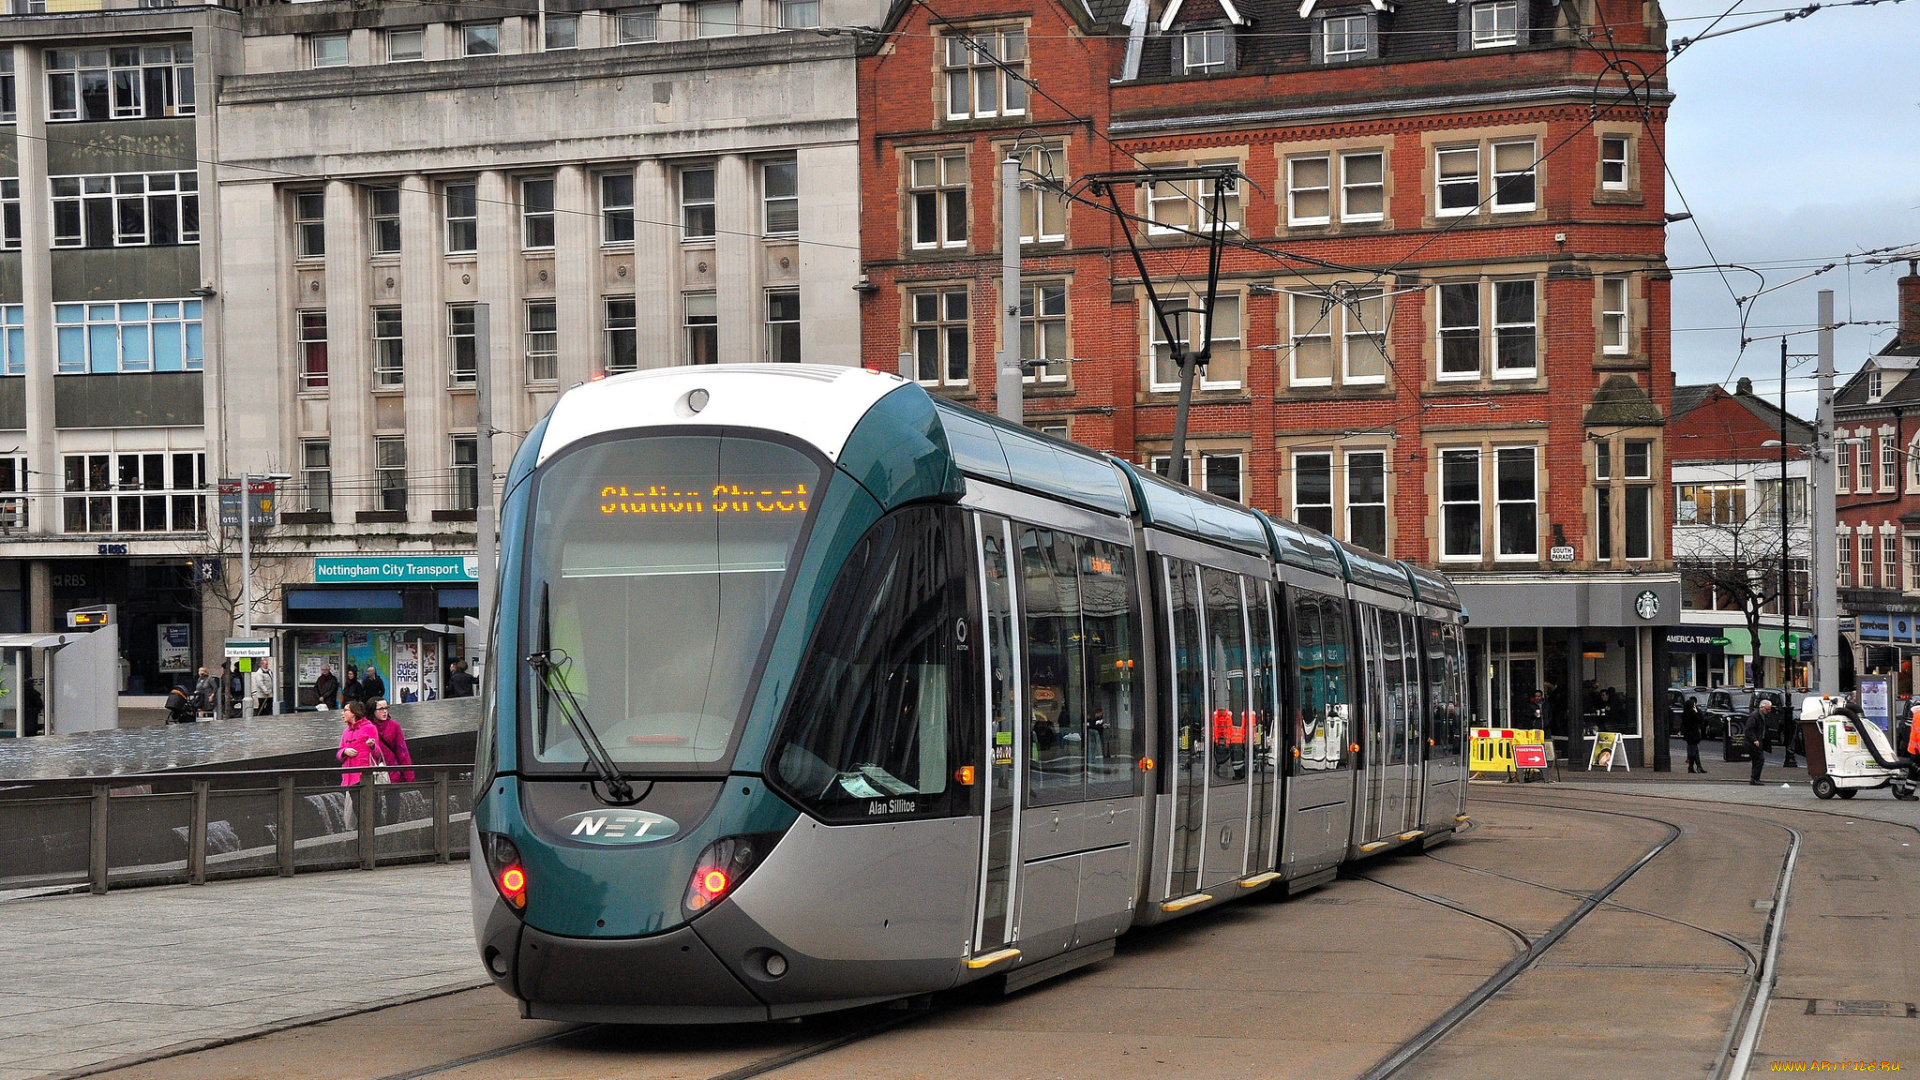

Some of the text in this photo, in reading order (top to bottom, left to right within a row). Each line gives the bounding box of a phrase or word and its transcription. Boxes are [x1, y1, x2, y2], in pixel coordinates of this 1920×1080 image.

[601, 484, 807, 513] Station Street
[108, 544, 127, 554] RBS
[1551, 553, 1573, 561] PARADE
[318, 563, 459, 578] Nottingham City Transport
[64, 574, 87, 587] RBS
[1666, 635, 1695, 644] AMERICA
[397, 661, 418, 669] inside
[397, 673, 418, 682] mind
[868, 798, 916, 815] Alan Sillitoe
[570, 816, 662, 837] NET
